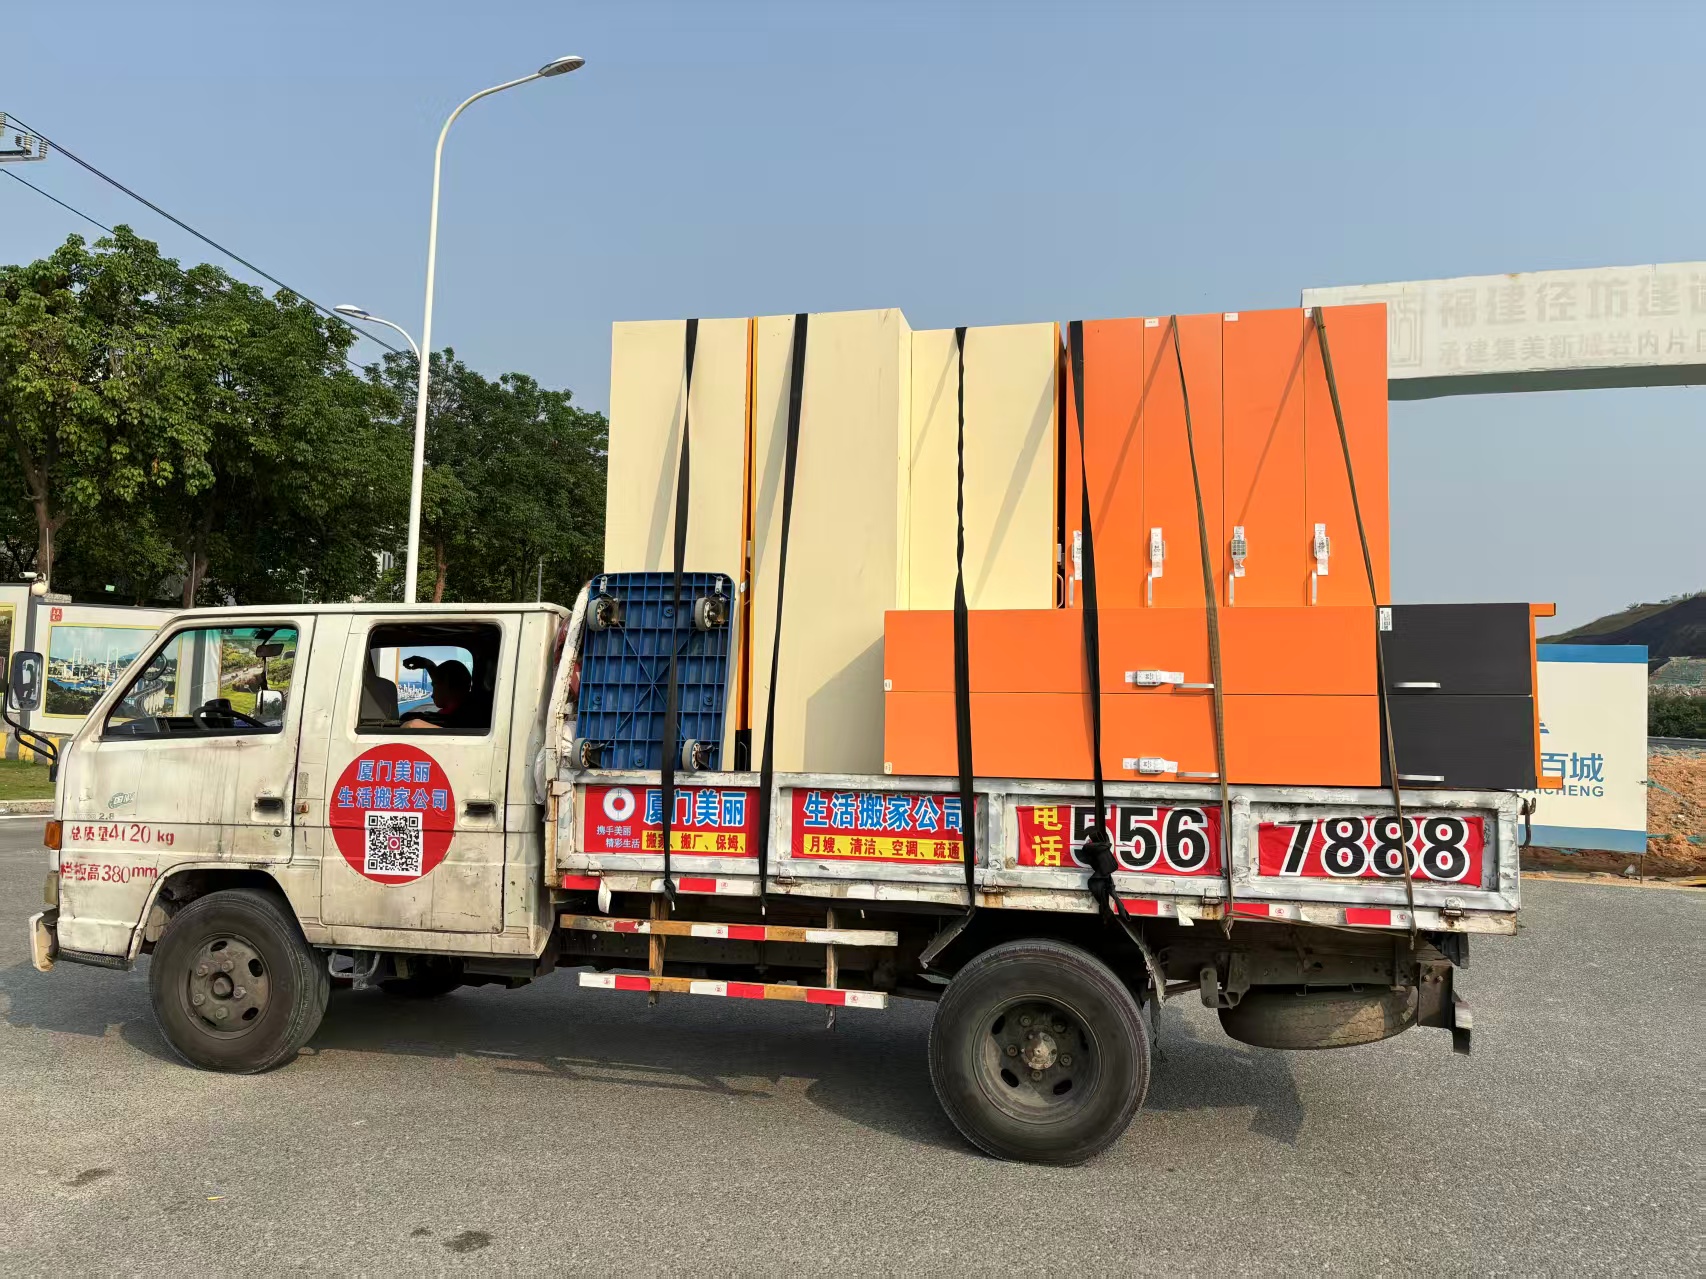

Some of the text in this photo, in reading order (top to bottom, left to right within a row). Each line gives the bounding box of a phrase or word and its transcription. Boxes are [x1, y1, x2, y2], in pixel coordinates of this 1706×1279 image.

[357, 759, 431, 782] 厦门美丽
[1541, 752, 1604, 782] 百城
[338, 786, 447, 811] 生活搬家公司
[643, 788, 747, 826] 厦门美丽
[98, 812, 115, 820] 2.8
[803, 791, 963, 834] 生活搬家公司
[157, 829, 175, 846] kg
[596, 825, 632, 836] 携手美丽
[605, 837, 641, 849] 精彩生活
[1032, 806, 1062, 866] 电话
[1274, 816, 1470, 881] 7888
